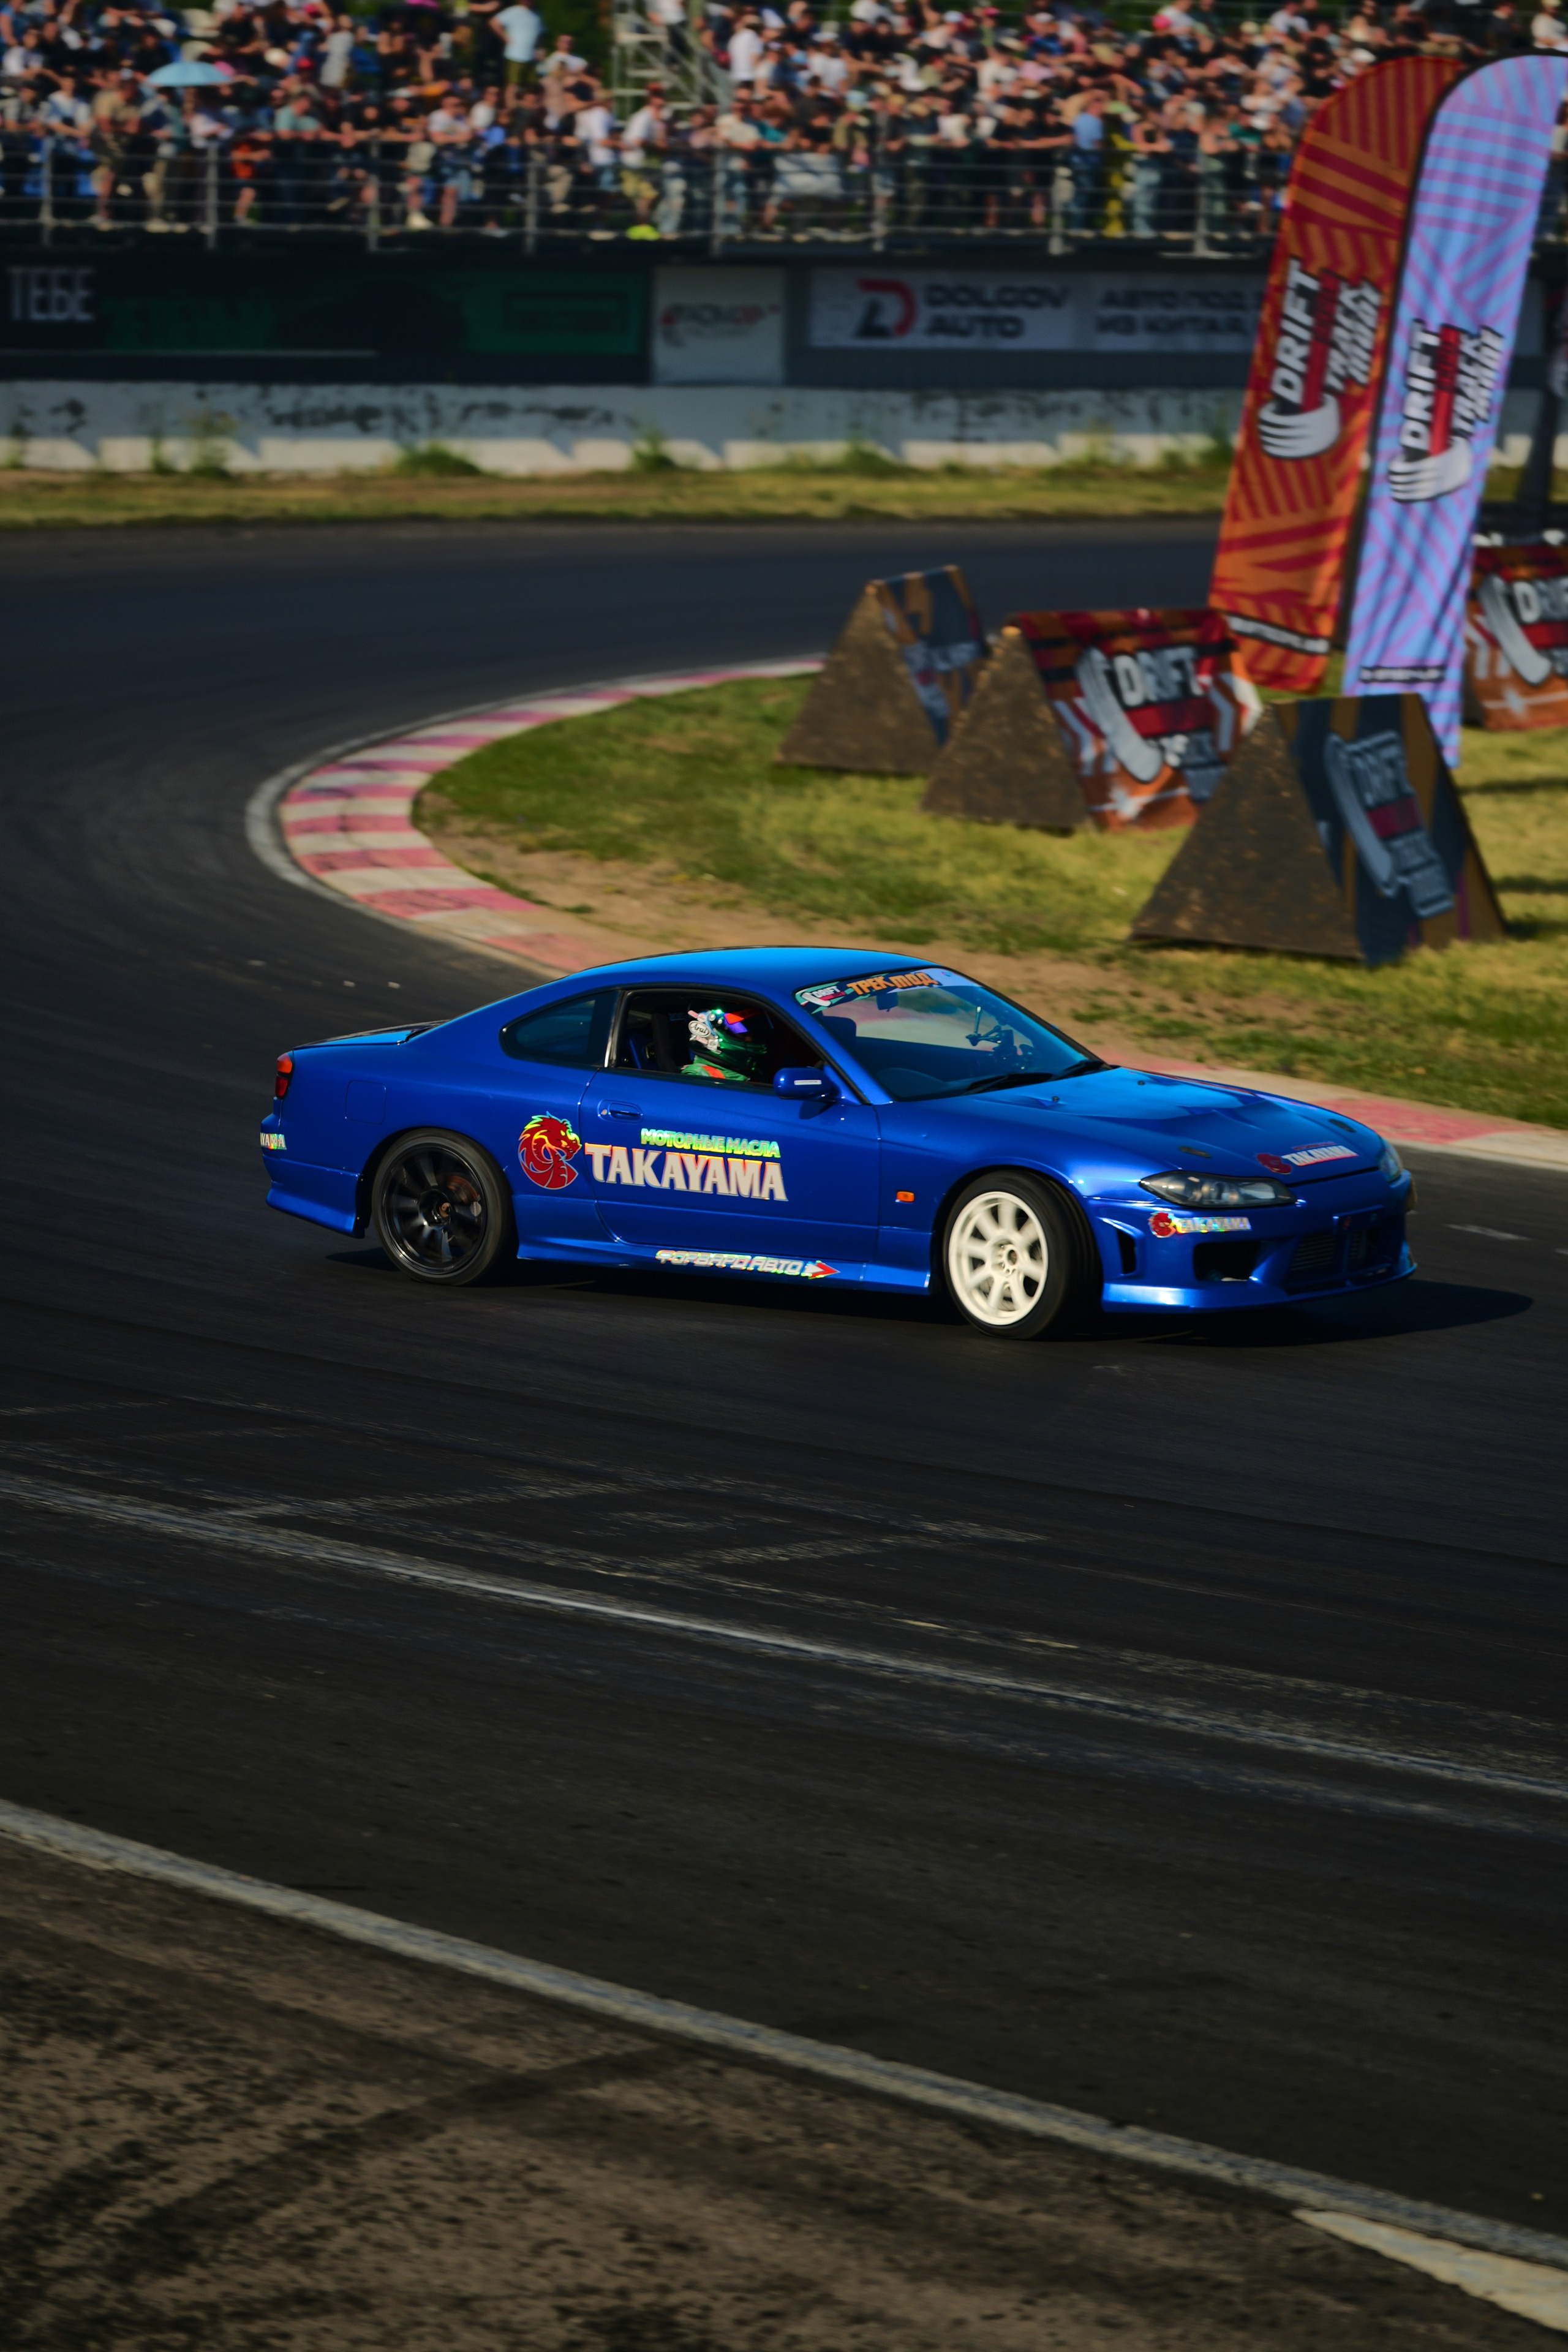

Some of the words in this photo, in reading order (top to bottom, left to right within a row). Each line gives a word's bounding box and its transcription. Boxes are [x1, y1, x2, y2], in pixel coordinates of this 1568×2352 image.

[924, 314, 1025, 339] AUTO
[1270, 257, 1321, 405] DRIFT
[1399, 318, 1441, 451] DRIFT
[689, 1023, 707, 1034] Arai
[641, 1128, 726, 1153] МОТОРНЫЕ
[726, 1137, 781, 1158] МАСЛА
[584, 1142, 789, 1202] TAKAYAMA
